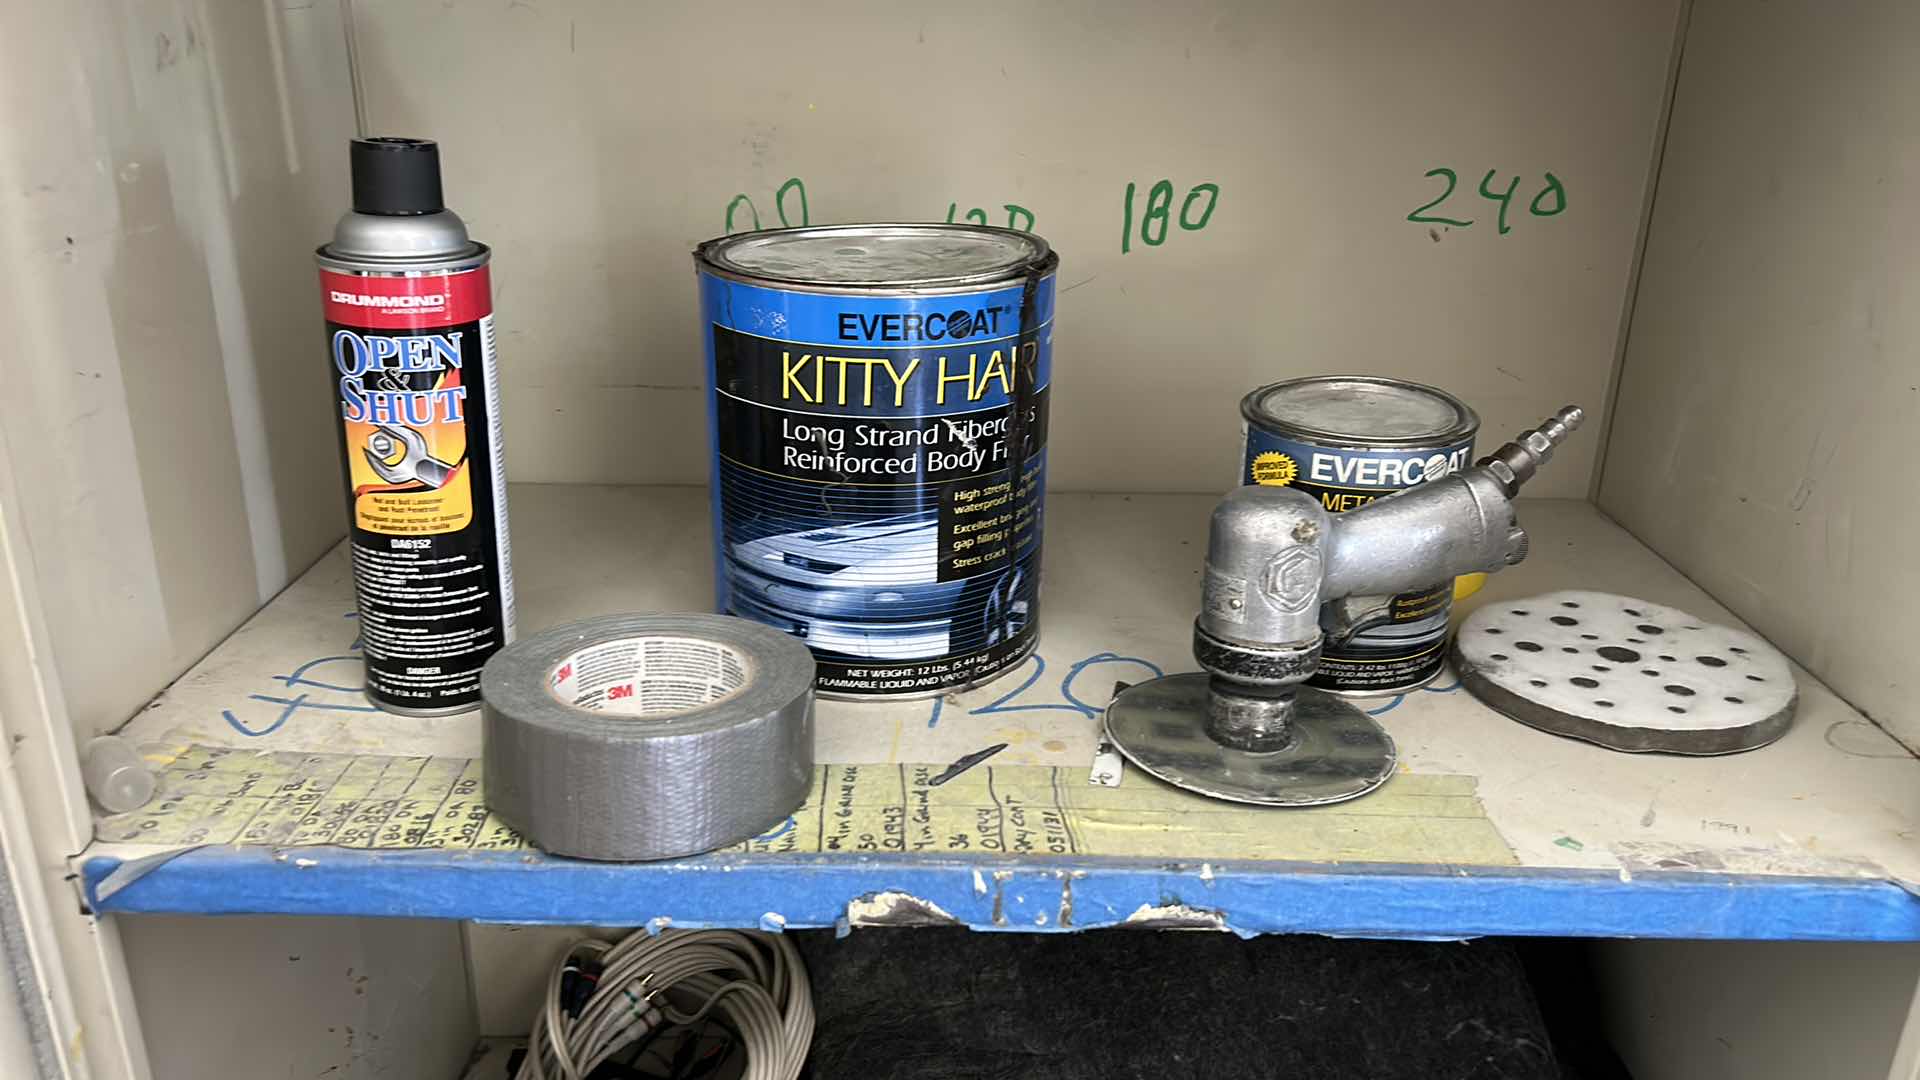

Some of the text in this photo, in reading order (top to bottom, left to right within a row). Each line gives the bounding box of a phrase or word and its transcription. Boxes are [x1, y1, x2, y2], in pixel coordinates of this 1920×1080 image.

[1408, 168, 1567, 235] 240
[1122, 180, 1220, 255] 180
[331, 291, 445, 307] DRUMMOND
[333, 330, 463, 378] OPEN
[377, 367, 411, 392] &
[782, 340, 1039, 407] KITTY HAIR
[340, 375, 467, 427] SHUT
[783, 418, 845, 450] Long
[855, 424, 939, 447] Strand
[783, 446, 918, 474] Reinforced
[928, 449, 986, 474] Body
[1311, 448, 1469, 486] EVERCOAT
[953, 488, 981, 503] High
[953, 517, 998, 535] Excellent
[391, 538, 433, 550] DA6152
[952, 537, 975, 552] gap
[976, 530, 1003, 545] filling
[952, 554, 982, 569] Stress
[406, 667, 442, 675] DANGER
[557, 663, 573, 684] 3M
[847, 668, 870, 679] NET
[871, 667, 915, 679] WEIGHT:
[918, 667, 930, 676] 12
[607, 684, 633, 701] 3M
[818, 677, 878, 690] FLAMMABLE
[880, 678, 914, 690] LIQUID
[915, 675, 939, 687] AND
